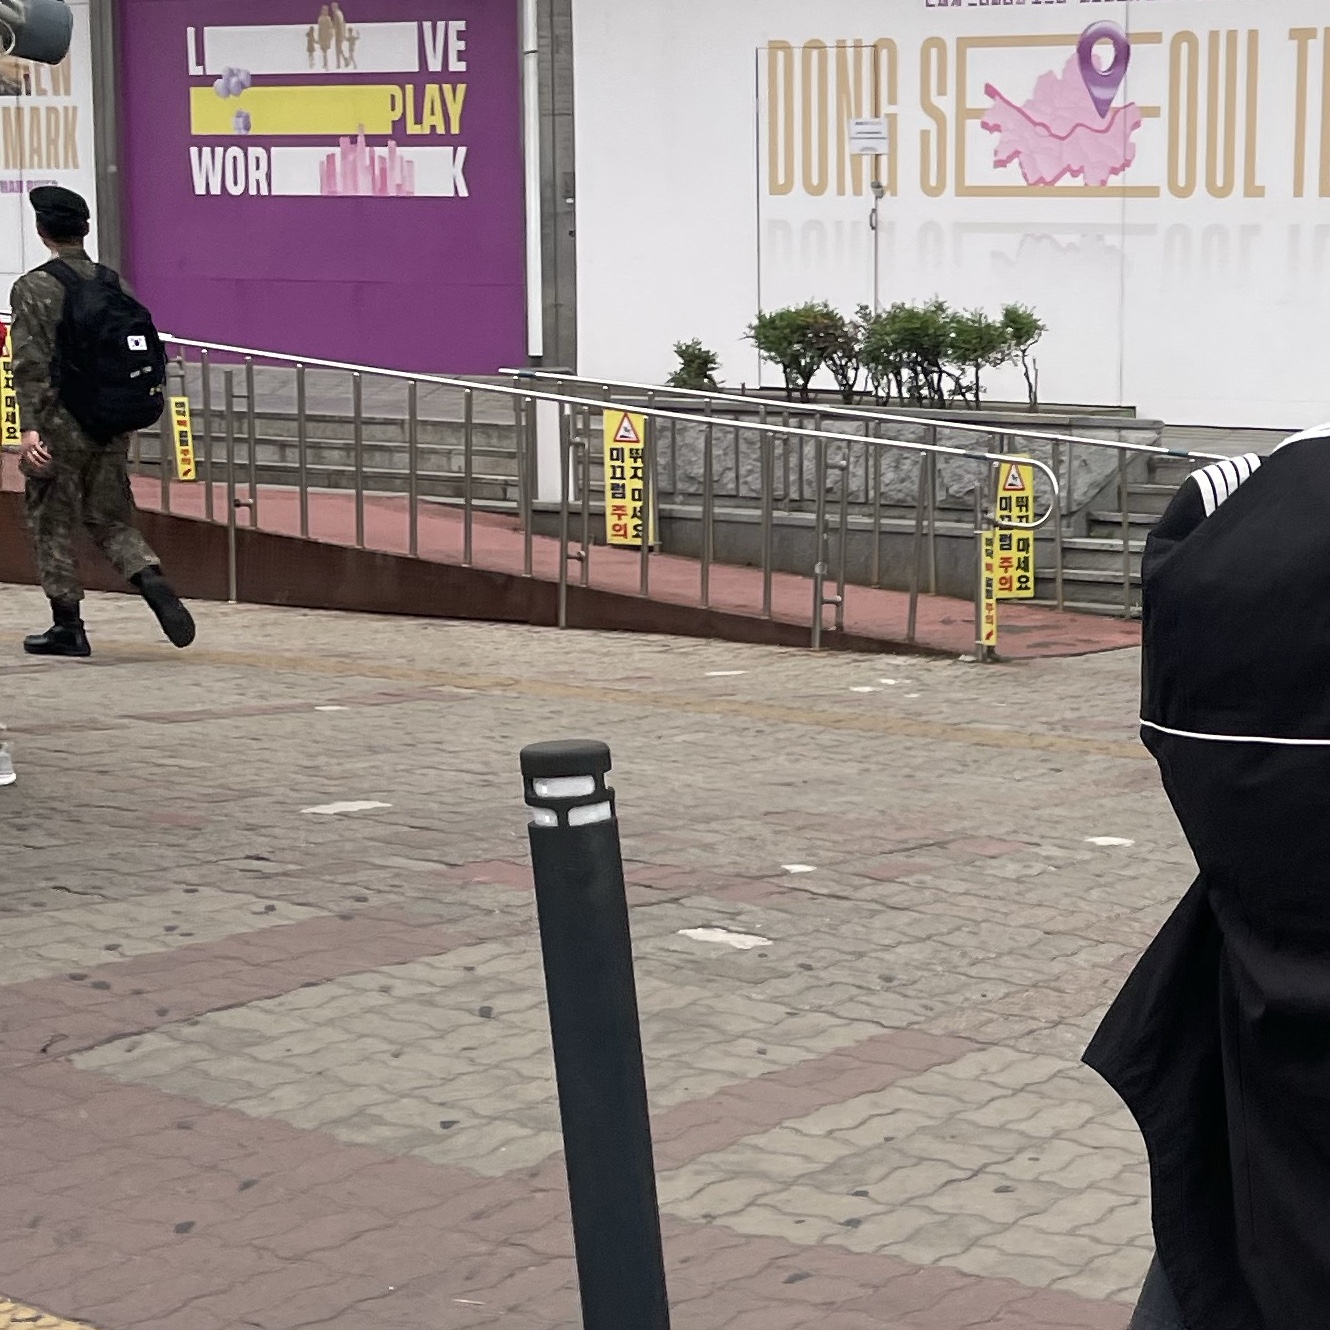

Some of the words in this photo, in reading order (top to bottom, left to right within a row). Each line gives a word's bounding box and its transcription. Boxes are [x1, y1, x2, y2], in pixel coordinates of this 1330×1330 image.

[189, 84, 467, 135] PLAY
[768, 37, 898, 197] DONG
[920, 29, 1266, 199] SEOUL
[189, 146, 469, 197] WORK
[610, 447, 626, 499] 미끄럼
[611, 504, 628, 539] 주의
[999, 556, 1014, 592] 주의
[1016, 537, 1032, 591] 마세요
